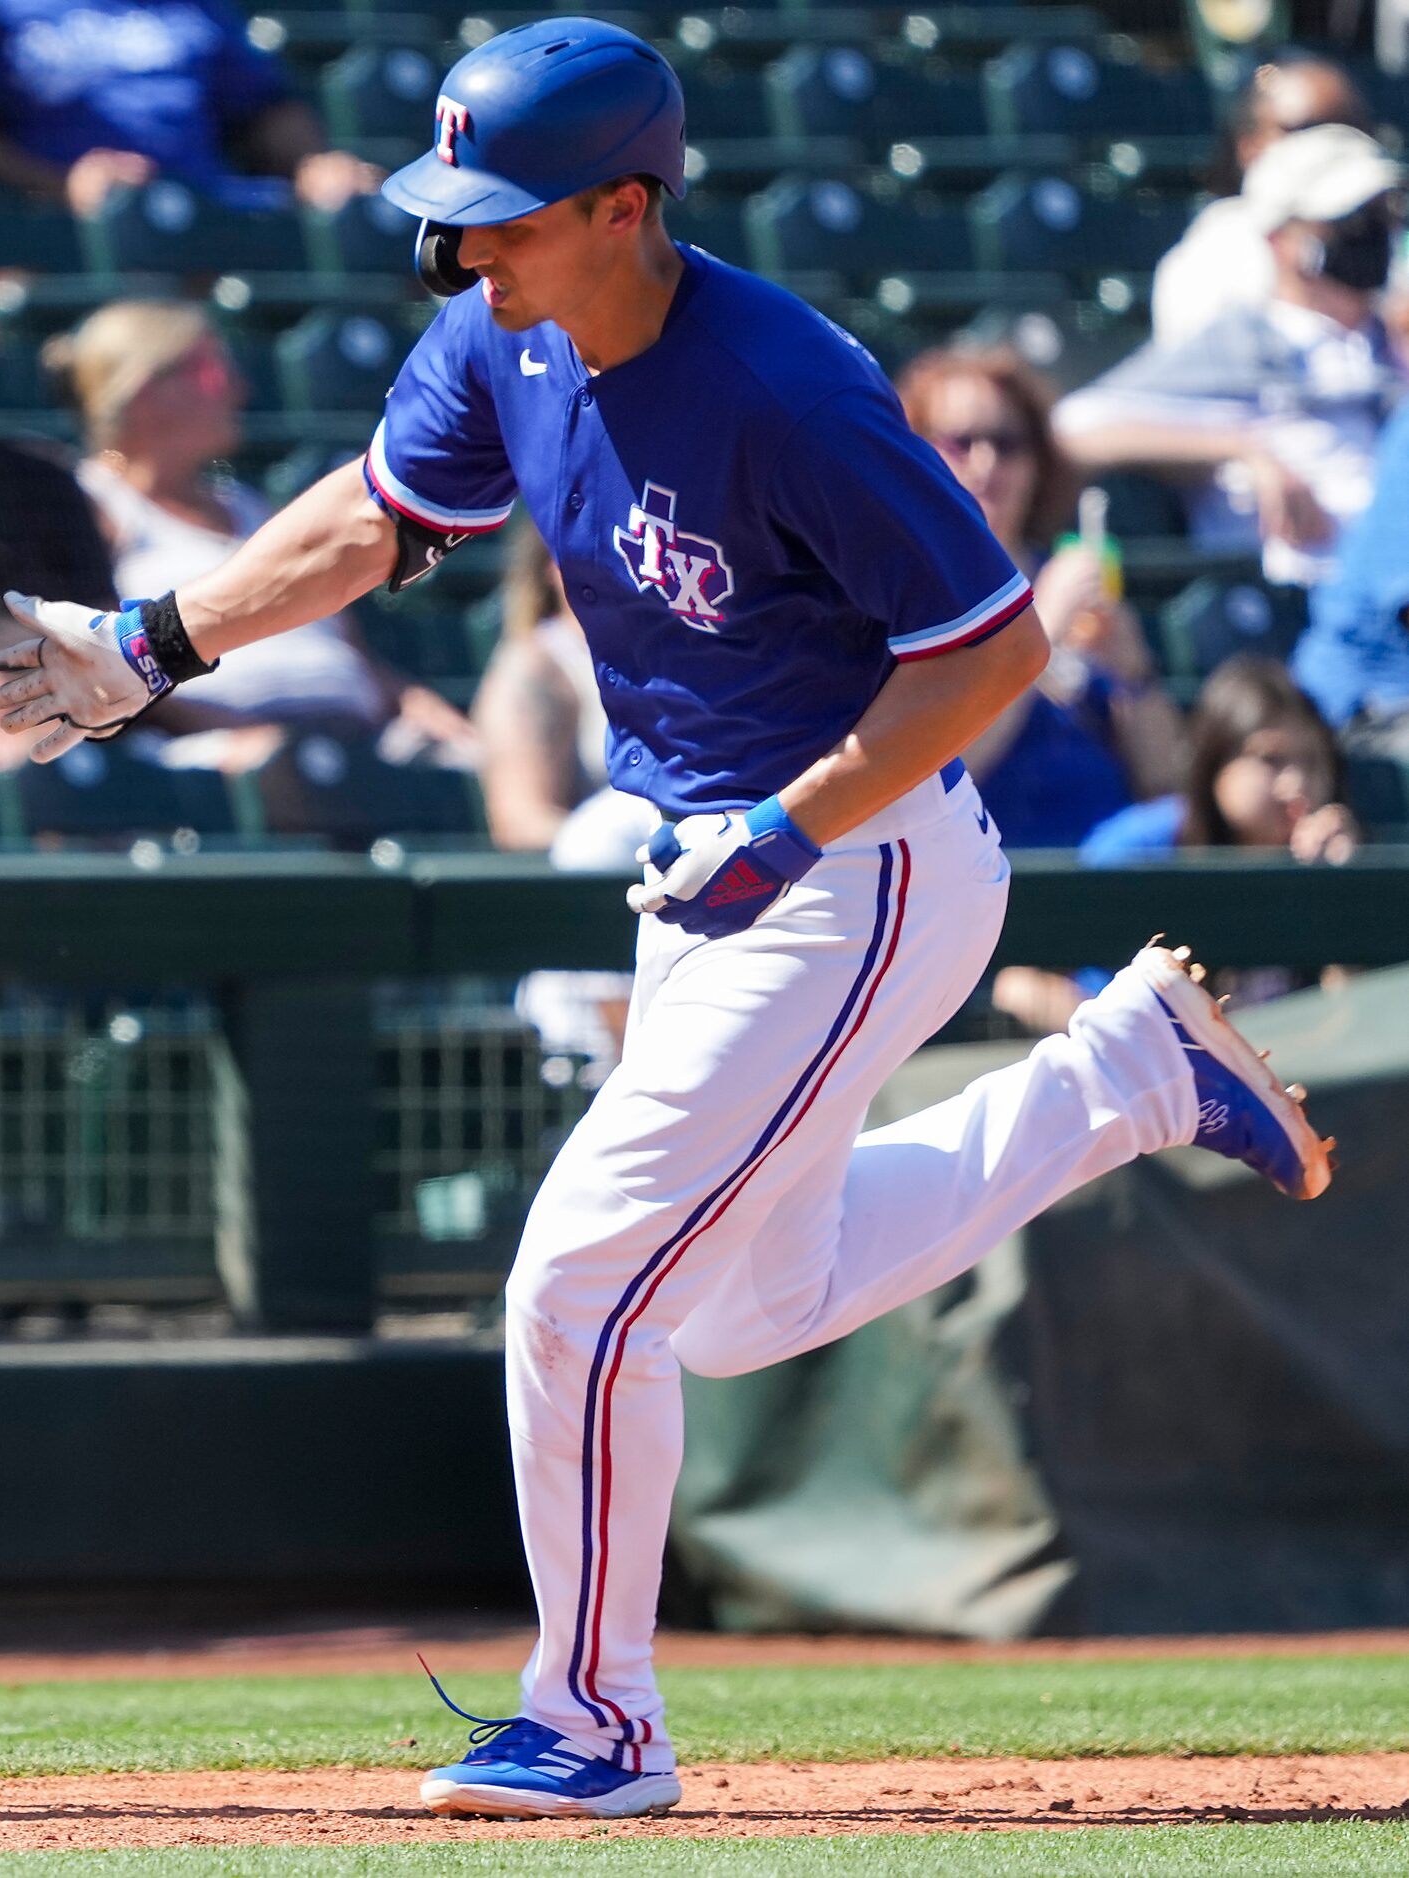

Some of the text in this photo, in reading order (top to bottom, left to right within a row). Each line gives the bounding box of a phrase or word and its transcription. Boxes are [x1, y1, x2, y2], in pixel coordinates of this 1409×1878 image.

[436, 94, 468, 165] T
[628, 502, 724, 622] TX
[706, 882, 776, 908] adidas
